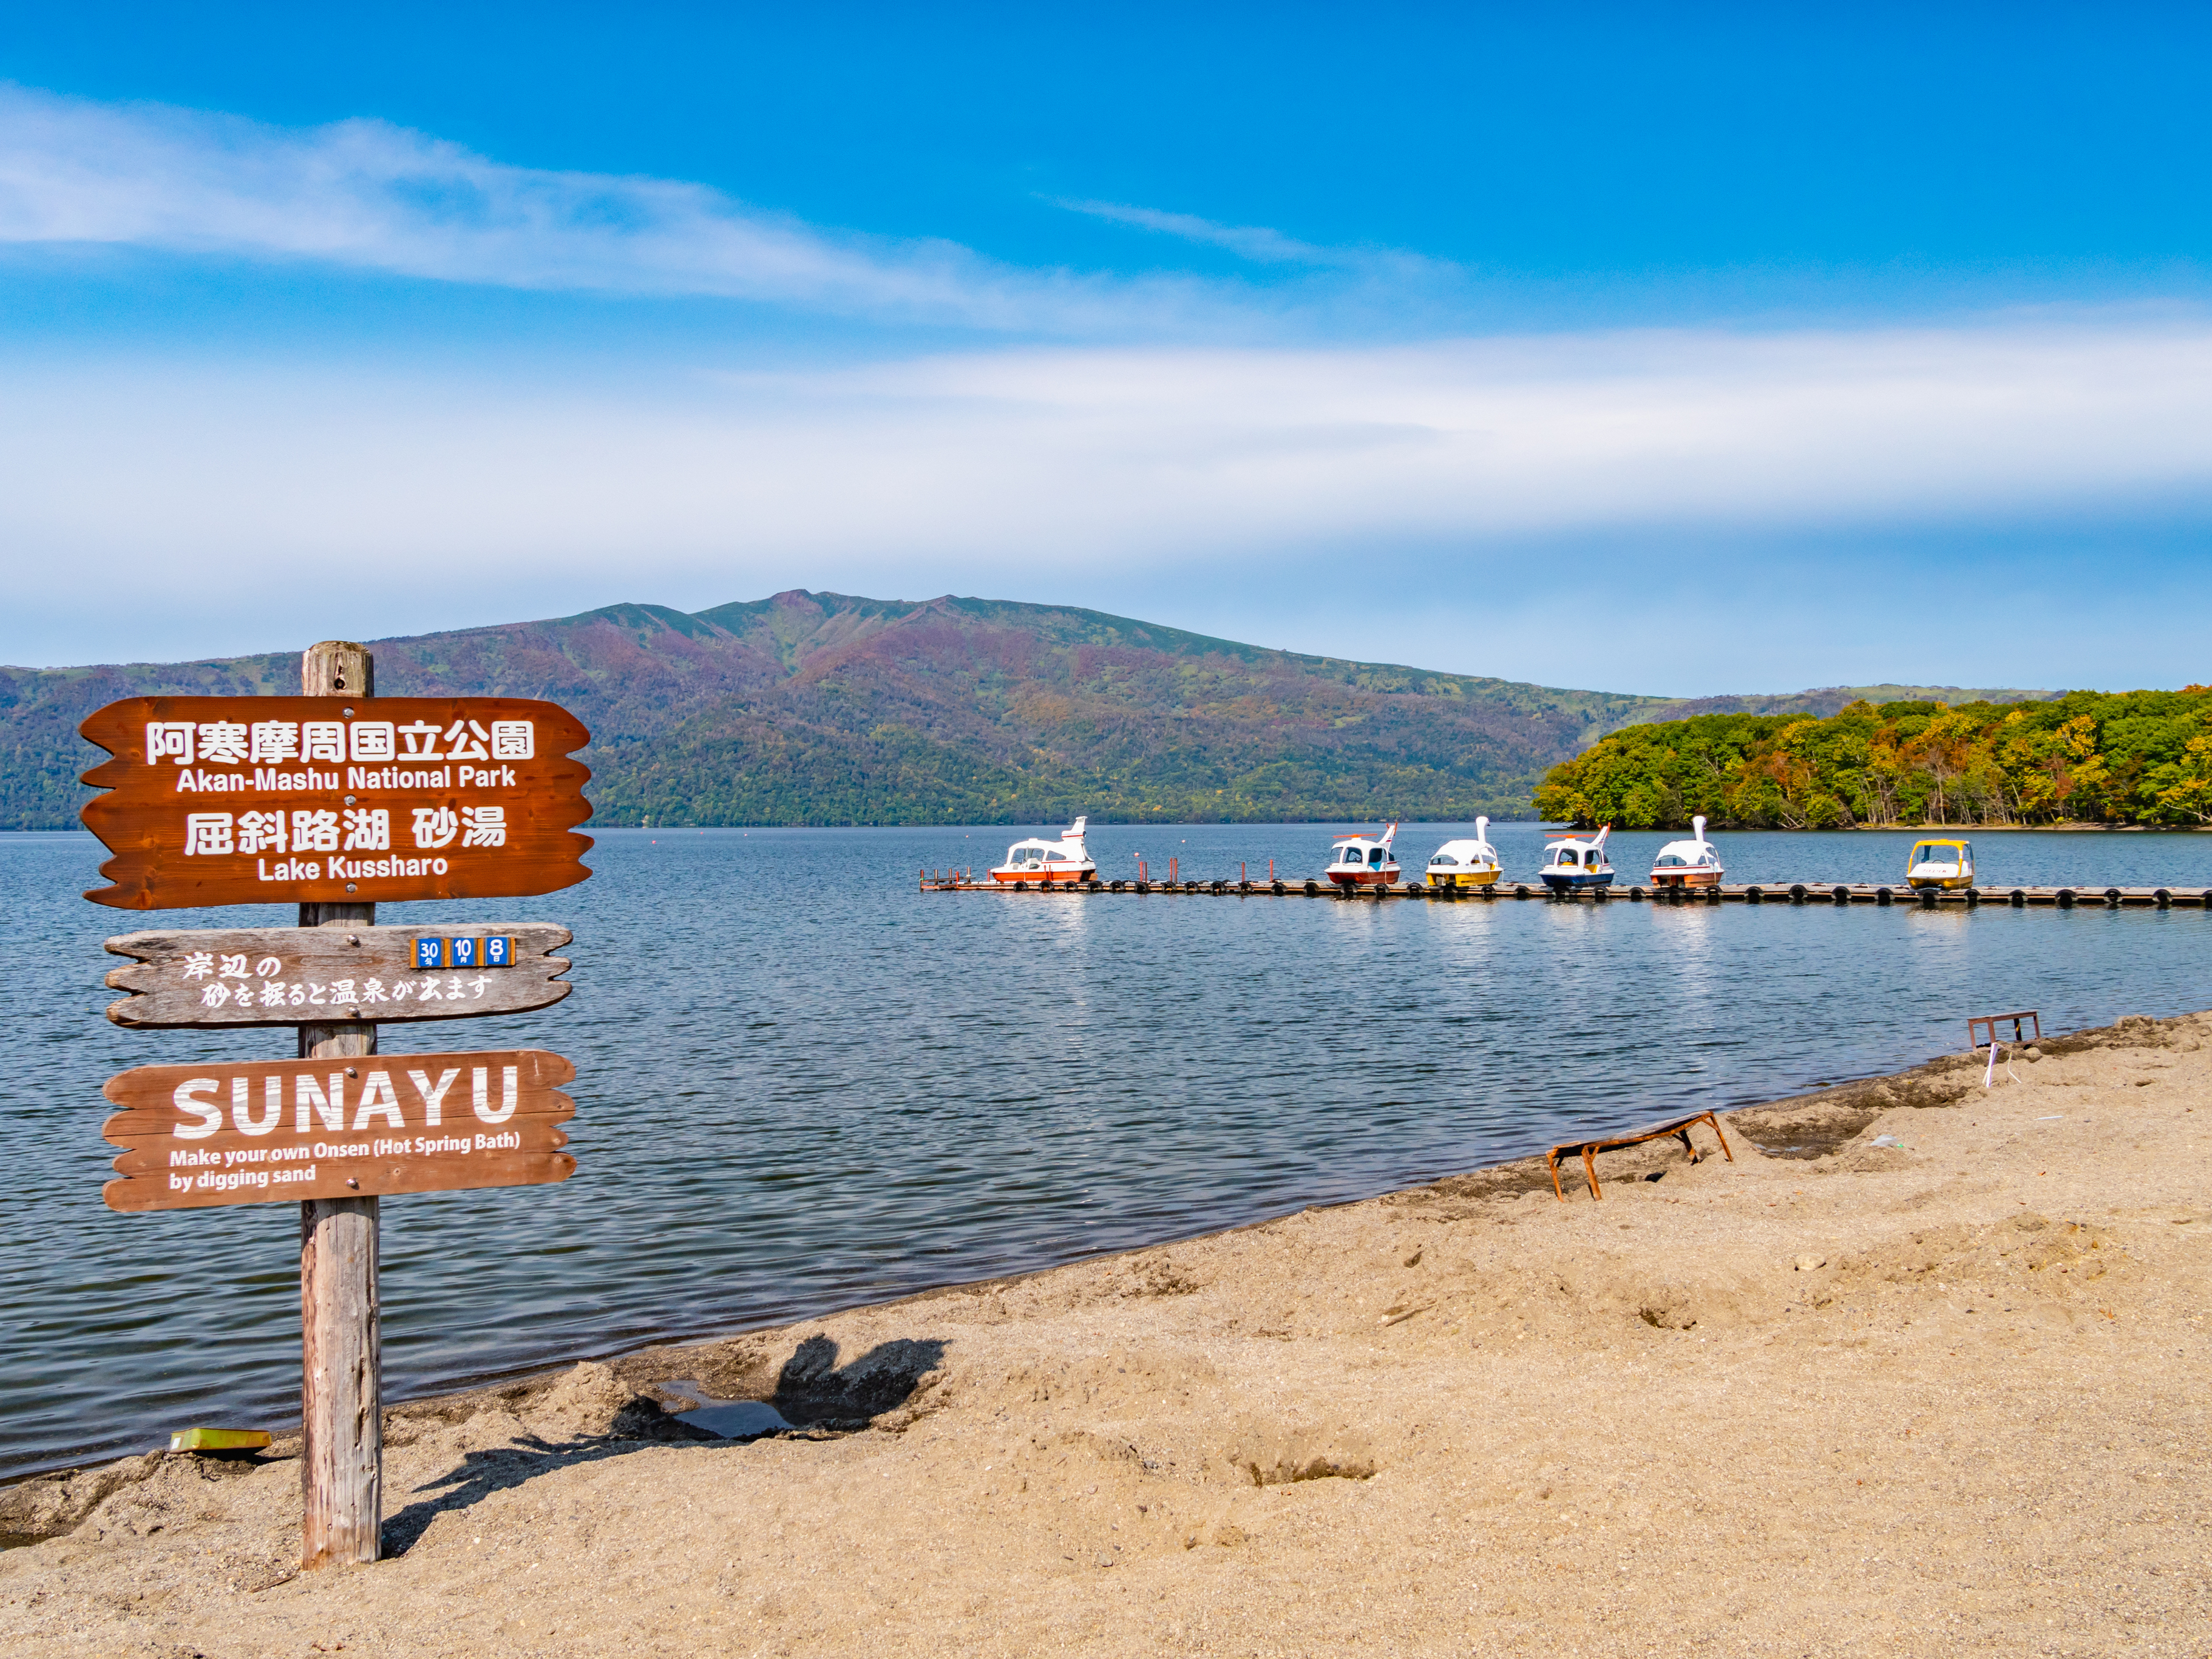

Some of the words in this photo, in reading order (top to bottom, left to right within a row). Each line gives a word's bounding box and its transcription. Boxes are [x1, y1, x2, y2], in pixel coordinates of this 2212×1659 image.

[146, 720, 535, 765] 阿寒摩周国立公園
[177, 767, 339, 792] Akan-Mashu
[348, 766, 450, 790] National
[459, 765, 516, 787] Park
[185, 809, 390, 857] 屈斜路湖
[412, 806, 507, 849] 砂湯
[259, 856, 321, 881] Lake
[328, 854, 448, 879] Kussharo
[420, 942, 438, 958] 30
[455, 939, 472, 957] 10
[489, 938, 504, 956] 8
[182, 951, 281, 981] 岸辺の
[201, 974, 492, 1008] 砂を掘ると温泉が出ます
[171, 1065, 518, 1140] SUNAYU
[169, 1148, 222, 1167] Make
[224, 1148, 268, 1168] your
[271, 1145, 311, 1162] own
[312, 1142, 370, 1159] Onsen
[373, 1138, 412, 1158] (Hot
[415, 1135, 472, 1156] Spring
[474, 1130, 521, 1152] Bath)
[169, 1172, 194, 1193] by
[195, 1168, 270, 1191] digging
[271, 1164, 316, 1184] sand
